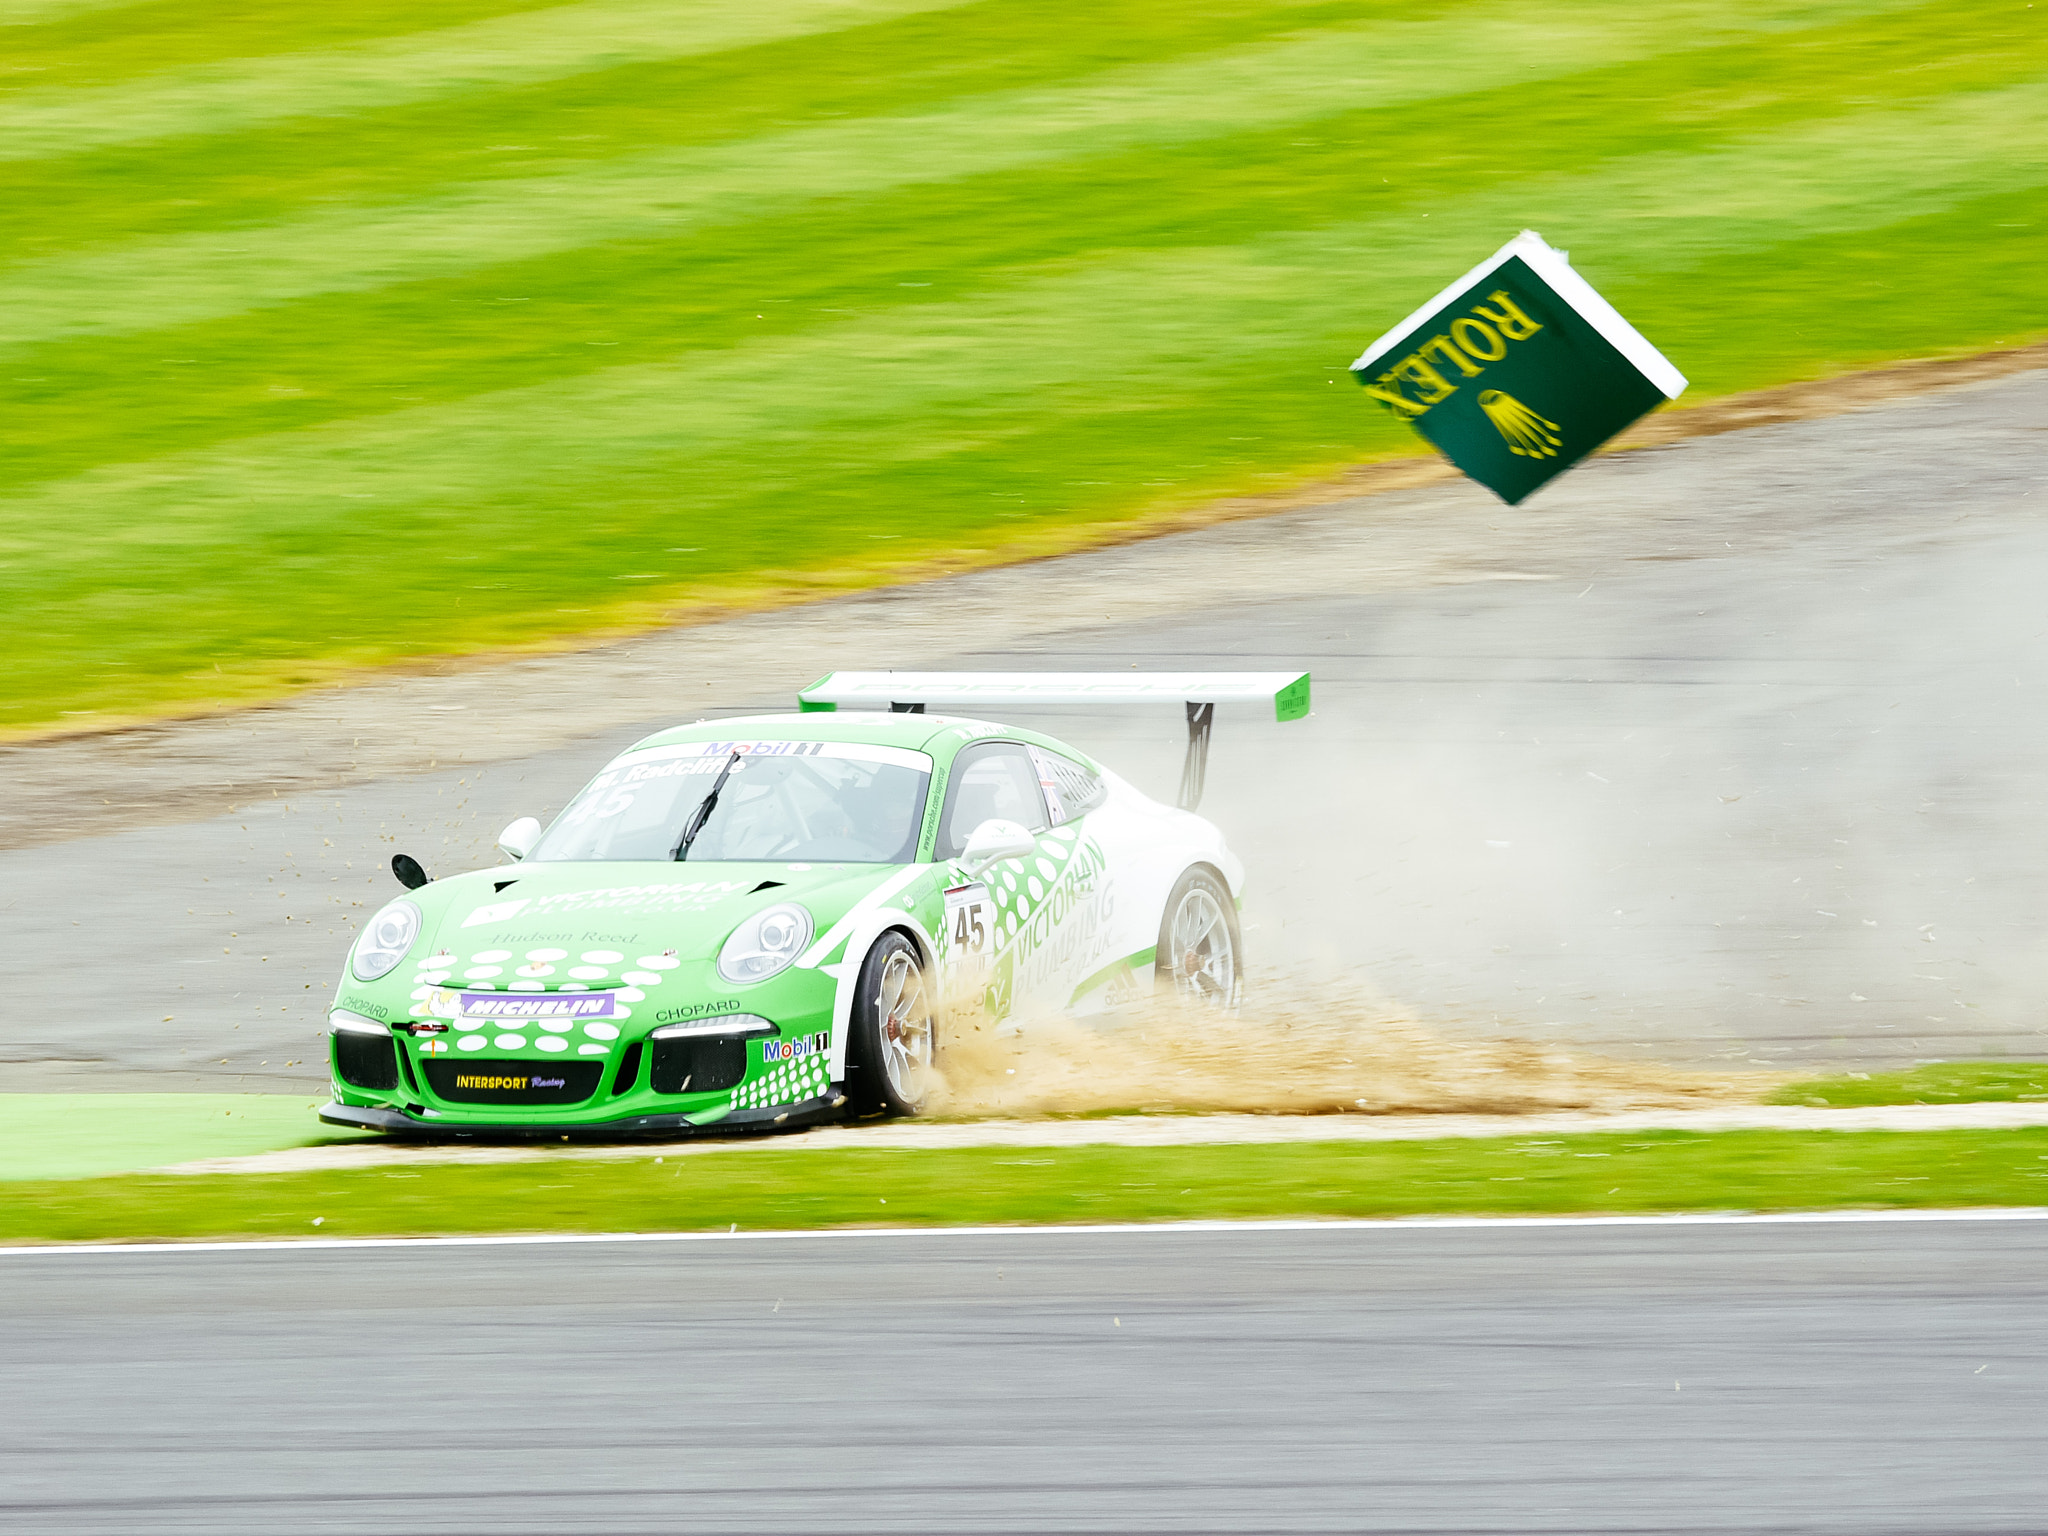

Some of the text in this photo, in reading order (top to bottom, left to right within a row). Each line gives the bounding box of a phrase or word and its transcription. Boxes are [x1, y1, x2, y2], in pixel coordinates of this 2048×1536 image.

[1364, 289, 1543, 422] ROLEX
[852, 683, 1258, 694] PORSCHE
[703, 742, 790, 756] Mobil
[488, 931, 646, 945] Hudson Reed
[955, 903, 985, 956] 45
[342, 995, 388, 1019] CHOPARD
[467, 999, 606, 1015] MICHELIN
[655, 1000, 741, 1022] CHOPARD
[763, 1035, 812, 1061] Mobil
[456, 1074, 528, 1090] INTERSPORT
